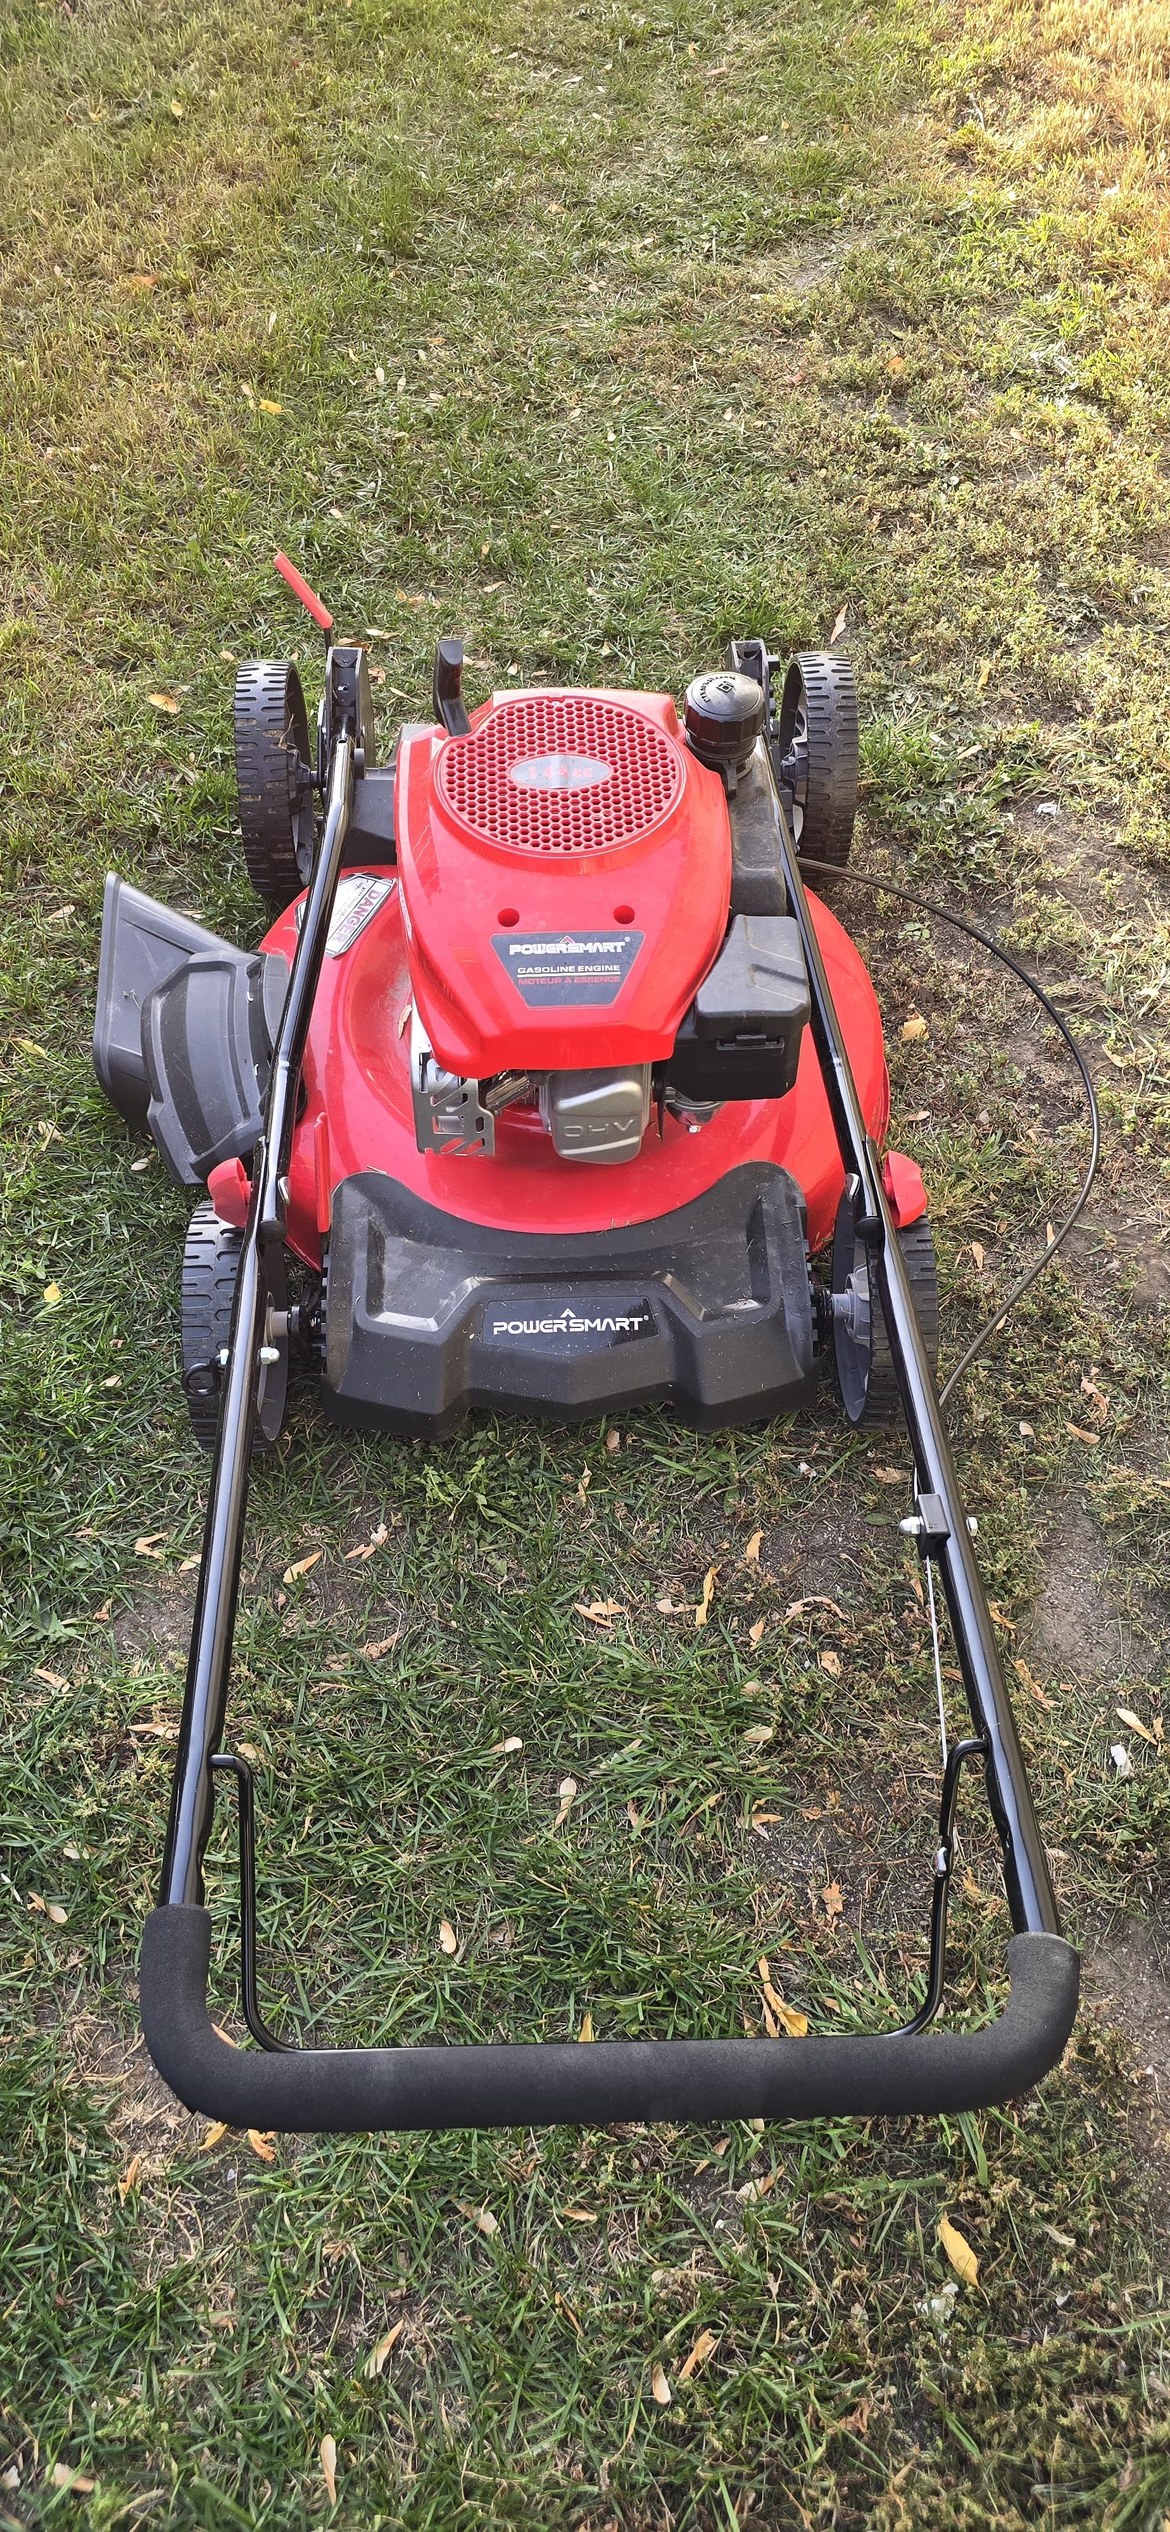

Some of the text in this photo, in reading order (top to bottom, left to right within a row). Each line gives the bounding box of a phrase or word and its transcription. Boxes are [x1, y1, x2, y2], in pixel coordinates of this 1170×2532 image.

[332, 889, 383, 943] DANGER
[518, 964, 621, 974] GASOLINE ENGINE
[518, 977, 562, 985] MOTEUR
[574, 976, 621, 984] ESSENCE
[563, 1119, 634, 1137] OHV
